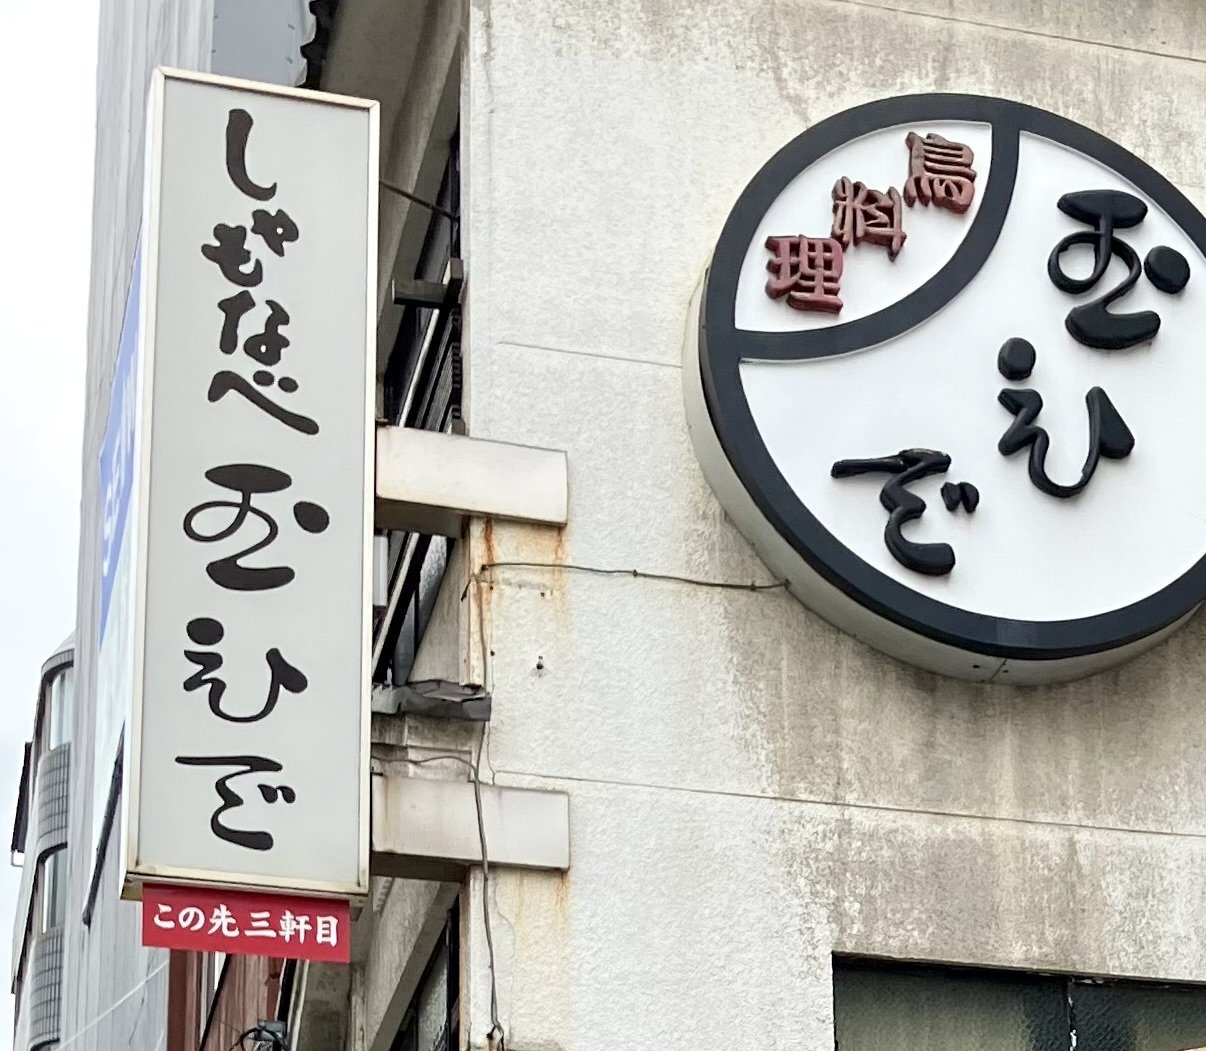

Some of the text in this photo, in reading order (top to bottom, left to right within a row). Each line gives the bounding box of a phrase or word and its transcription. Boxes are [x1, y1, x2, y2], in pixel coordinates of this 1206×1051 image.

[765, 130, 978, 315] 鳥料理
[153, 903, 339, 947] この先三軒目
